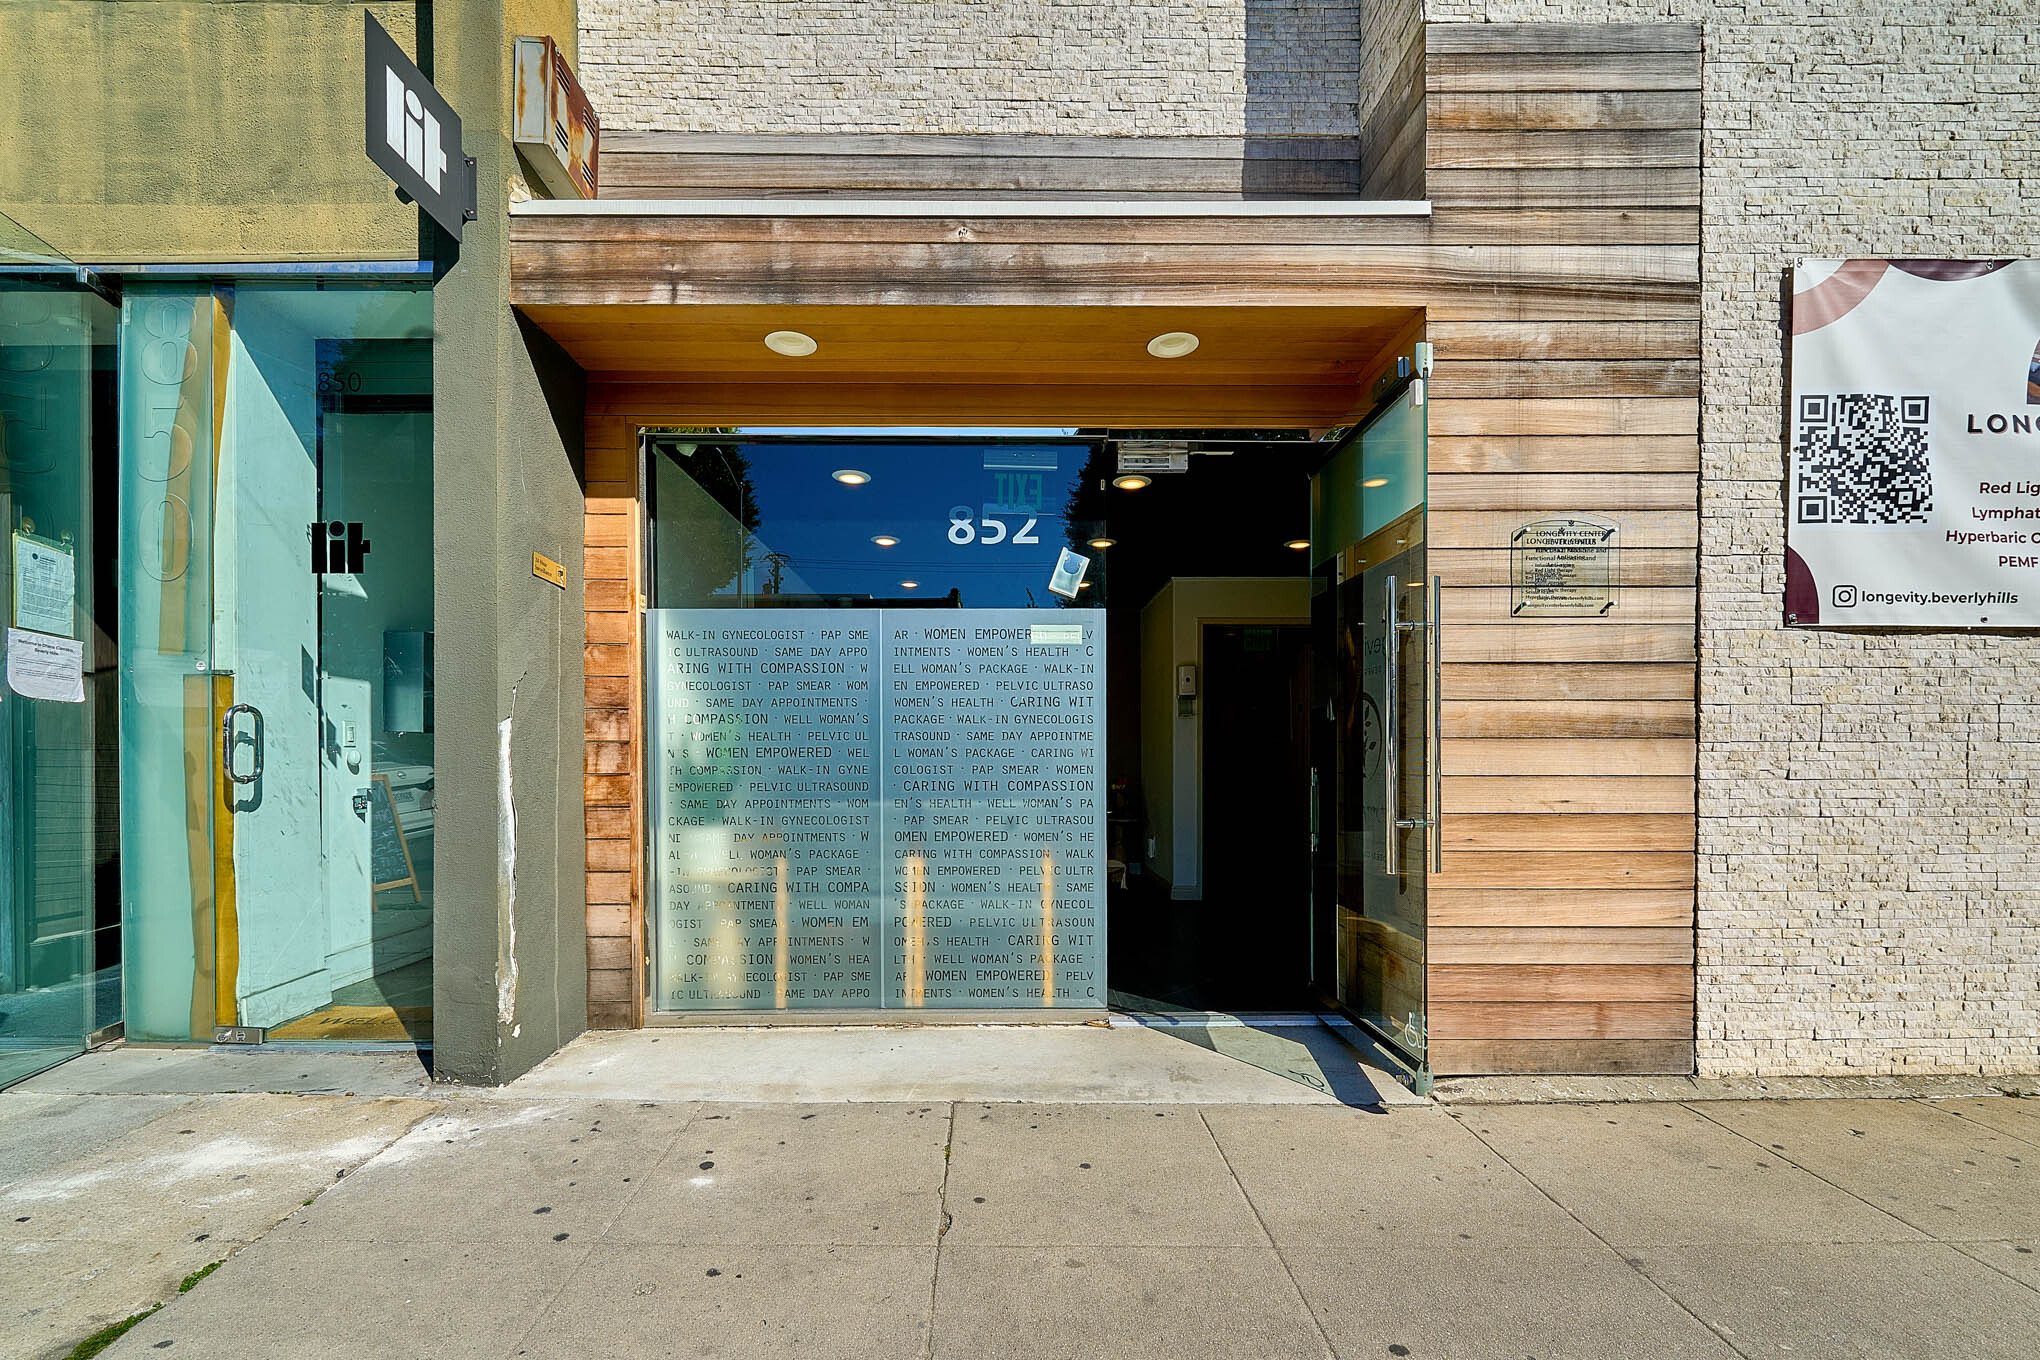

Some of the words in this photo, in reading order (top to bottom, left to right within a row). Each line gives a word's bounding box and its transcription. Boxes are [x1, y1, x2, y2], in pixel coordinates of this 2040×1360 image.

[318, 372, 362, 392] 850
[1968, 413, 2040, 434] LON
[1980, 482, 2011, 494] Red
[2017, 482, 2040, 496] Lig
[1972, 507, 2040, 521] Lymphat
[947, 505, 1040, 545] 852
[1946, 530, 2026, 544] Hyperbaric
[1999, 555, 2038, 568] PEMF
[1862, 591, 2018, 606] longevity.beverlyhills
[666, 630, 715, 640] WALK-IN
[722, 629, 804, 639] GYNECOLOGIST
[821, 630, 841, 640] PAP
[849, 631, 868, 639] SME
[894, 630, 908, 639] AR
[925, 629, 965, 639] WOMEN
[686, 648, 758, 656] ULTRASOUND
[775, 647, 802, 656] SAME
[809, 647, 831, 656] DAY
[839, 648, 867, 656] APPO
[894, 648, 950, 656] INTMENTS
[968, 647, 1019, 656] WOMEN'S
[1026, 648, 1068, 656] HEALTH
[717, 663, 751, 673] WITH
[761, 663, 844, 673] COMPASSION
[860, 664, 867, 673] W
[894, 664, 915, 673] ELL
[922, 662, 971, 673] WOMAN'S
[979, 664, 1028, 673] PACKAGE
[1044, 664, 1093, 673] WALK-IN
[769, 682, 788, 690] PAP
[797, 682, 831, 690] SMEAR
[847, 682, 868, 690] WOM
[894, 681, 907, 690] EN
[916, 681, 979, 690] EMPOWERED
[996, 681, 1038, 690] PELVIC
[1043, 681, 1093, 690] ULTRASO
[706, 699, 734, 707] SAME
[742, 699, 762, 707] DAY
[770, 699, 857, 707] APPOINTMENTS
[895, 697, 943, 707] WOMEN'S
[952, 698, 993, 707] HEALTH
[1011, 697, 1062, 707] CARING
[1069, 697, 1093, 709] WIT
[784, 715, 812, 723] WELL
[818, 713, 868, 723] WOMAN'S
[895, 715, 944, 723] PACKAGE
[957, 715, 1008, 723] WALK-IN
[1014, 715, 1093, 723] GYNECOLOGIS
[749, 732, 791, 740] HEALTH
[808, 732, 849, 740] PELVIC
[853, 732, 869, 740] UL
[894, 732, 950, 740] TRASOUND
[967, 732, 995, 741] SAME
[1002, 732, 1023, 740] DAY
[1030, 732, 1093, 740] APPOINTME
[705, 748, 748, 757] WOMEN
[756, 748, 831, 758] EMPOWERED
[848, 749, 869, 757] WEL
[908, 747, 957, 757] WOMAN'S
[966, 747, 1014, 757] PACKAGE
[1031, 749, 1073, 757] CARING
[1081, 749, 1094, 757] WI
[778, 766, 829, 774] WALK-IN
[839, 766, 868, 774] GYNE
[894, 766, 953, 774] COLOGIST
[971, 766, 993, 774] PAP
[1001, 766, 1038, 774] SMEAR
[1056, 766, 1093, 774] WOMEN
[669, 783, 733, 791] EMPOWERED
[750, 783, 792, 791] PELVIC
[798, 783, 869, 791] ULTRASOUND
[904, 781, 954, 791] CARING
[964, 781, 998, 792] WITH
[1008, 781, 1093, 791] COMPASSION
[680, 800, 708, 808] SAME
[716, 800, 737, 808] DAY
[745, 800, 830, 808] APPOINTMENTS
[846, 800, 868, 808] WOM
[895, 799, 922, 808] EN'S
[930, 799, 971, 808] HEALTH
[987, 799, 1016, 808] WELL
[1022, 798, 1072, 808] WOMAN'S
[1080, 799, 1093, 808] PA
[669, 817, 704, 825] CKAGE
[722, 817, 773, 825] WALK-IN
[782, 817, 869, 825] GYNECOLOGIST
[904, 816, 924, 824] PAP
[933, 816, 968, 824] SMEAR
[985, 816, 1028, 824] PELVIC
[1037, 816, 1093, 824] ULTRASOU
[895, 832, 927, 841] OMEN
[935, 832, 1008, 842] EMPOWERED
[1024, 831, 1072, 841] WOMEN'S
[1080, 832, 1094, 843] HE
[750, 849, 800, 858] WOMAN'S
[809, 850, 859, 858] PACKAGE
[895, 850, 936, 858] CARING
[944, 850, 971, 858] WITH
[979, 848, 1049, 858] COMPASSION
[1066, 849, 1094, 858] WALK
[797, 866, 817, 875] PAP
[824, 867, 861, 875] SMEAR
[938, 867, 1000, 875] EMPOWERED
[1066, 867, 1093, 875] ULTR
[728, 882, 777, 893] CARING
[786, 883, 818, 893] WITH
[827, 883, 869, 893] COMPA
[952, 882, 1000, 892] WOMEN'S
[1067, 884, 1094, 892] SAME
[670, 901, 690, 909] DAY
[799, 900, 828, 909] WELL
[834, 901, 869, 909] WOMAN
[981, 901, 1032, 909] WALK-IN
[802, 916, 843, 927] WOMEN
[853, 918, 868, 928] EM
[970, 918, 1015, 926] PELVIC
[947, 937, 988, 945] HEALTH
[1068, 935, 1093, 945] WIT
[790, 954, 840, 963] WOMEN'S
[849, 955, 870, 963] HEA
[934, 955, 965, 963] WELL
[971, 953, 1022, 963] WOMAN'S
[824, 972, 843, 982] PAP
[851, 973, 870, 981] SME
[926, 971, 966, 980] WOMEN
[977, 971, 1048, 980] EMPOWERED
[1066, 972, 1093, 980] PELV
[813, 989, 834, 998] DAY
[841, 990, 869, 998] APPO
[969, 987, 1018, 998] WOMEN'S
